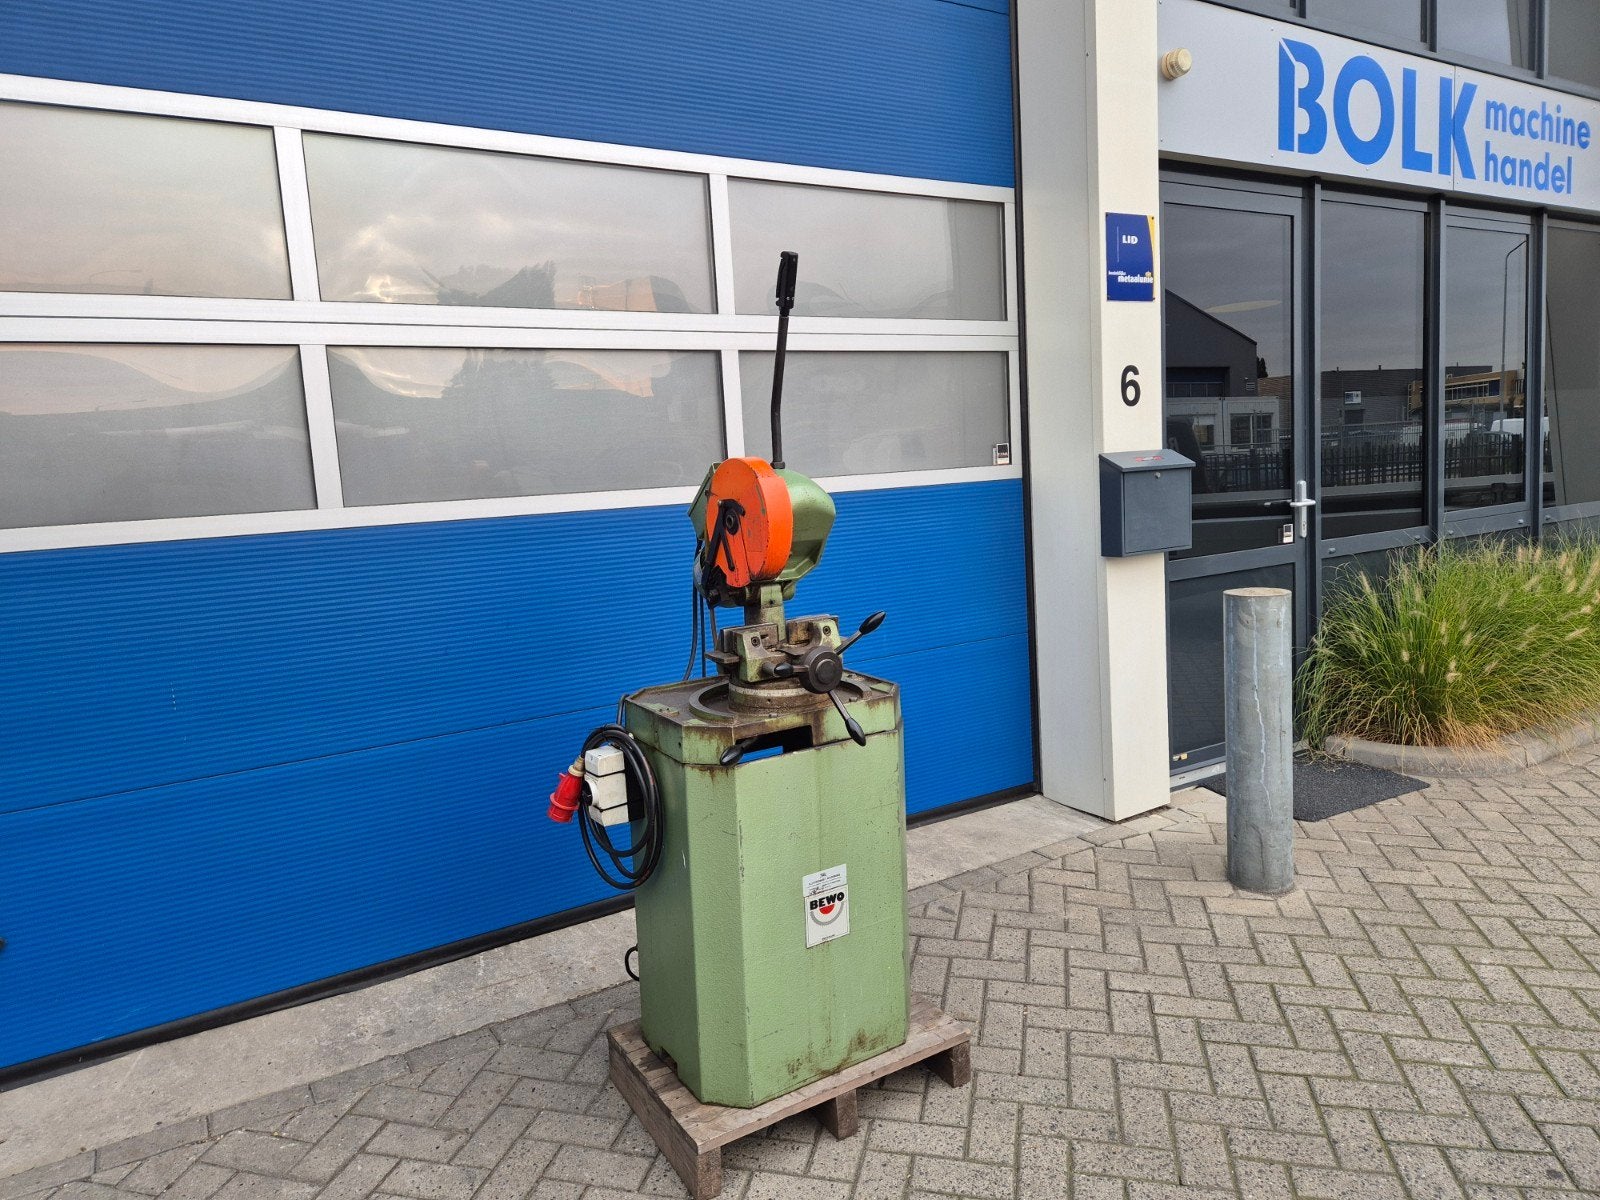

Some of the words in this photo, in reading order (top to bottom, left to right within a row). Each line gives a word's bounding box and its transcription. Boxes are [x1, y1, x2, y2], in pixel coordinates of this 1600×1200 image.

[1278, 37, 1478, 180] BOLK
[1485, 99, 1591, 149] machine
[1484, 140, 1572, 194] handel
[1122, 234, 1138, 244] LID
[1121, 364, 1141, 407] 6
[809, 891, 845, 911] BEWO
